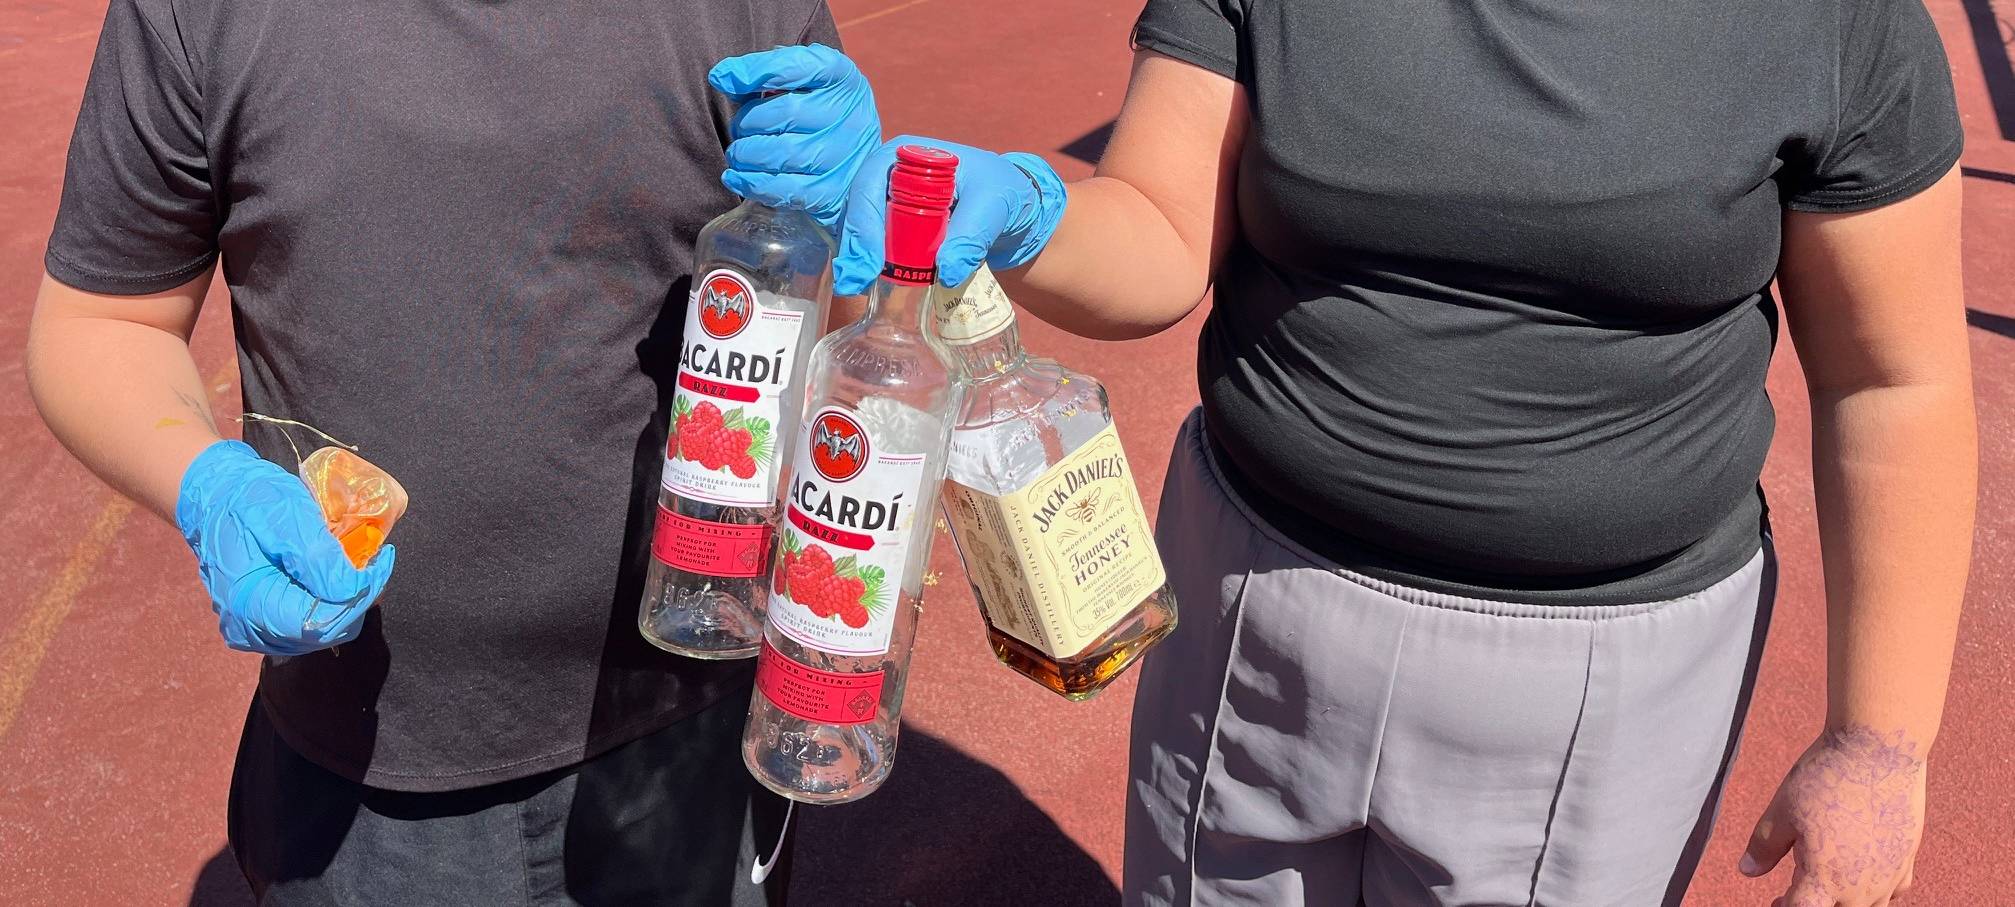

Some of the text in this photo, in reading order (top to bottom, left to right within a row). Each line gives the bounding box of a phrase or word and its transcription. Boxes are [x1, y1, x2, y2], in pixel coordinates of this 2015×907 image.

[680, 340, 785, 384] ACARDÍ
[693, 381, 728, 397] RAZZ
[791, 472, 903, 531] ACARDÍ
[1032, 484, 1069, 533] JACK
[1064, 453, 1123, 495] DANIEL'S
[676, 535, 703, 545] PERFECT
[698, 526, 742, 537] MIXING
[802, 520, 839, 542] RAZZ
[1061, 535, 1087, 556] SMOOTH
[1093, 506, 1125, 532] BALANCED
[670, 546, 720, 560] YOUR FAVOURITE
[676, 542, 715, 554] MIXING WITH
[1069, 523, 1126, 572] Tennessee
[676, 554, 710, 566] LEMONADE
[1074, 534, 1130, 586] HONEY
[1010, 505, 1064, 645] JACK DANIEL DISTILLERY
[783, 678, 810, 692] PERFECT
[806, 674, 852, 686] MIXING
[777, 687, 830, 709] YOUR FAVOURITE
[782, 684, 824, 702] MIXING WITH
[783, 697, 819, 714] LEMONADE
